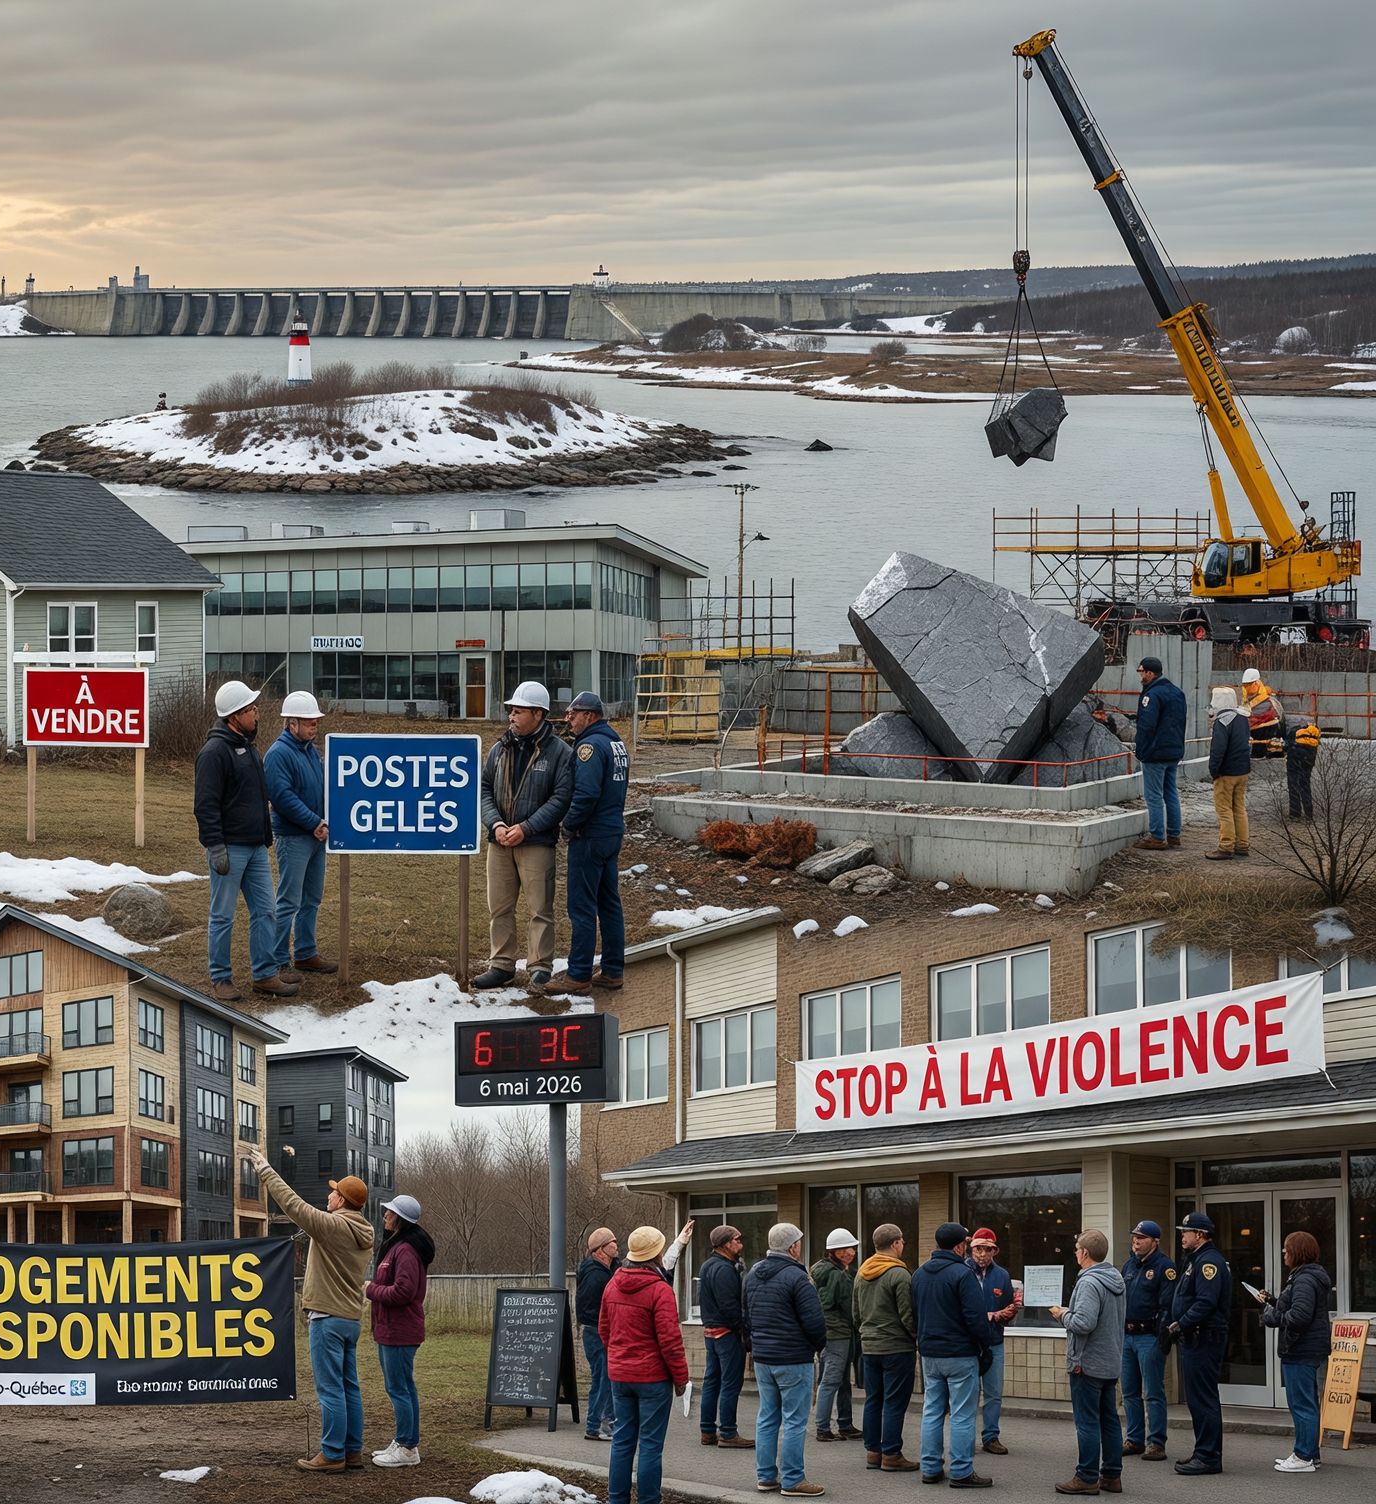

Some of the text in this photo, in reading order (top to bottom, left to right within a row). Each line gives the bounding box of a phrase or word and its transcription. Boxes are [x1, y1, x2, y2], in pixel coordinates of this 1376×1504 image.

[75, 675, 95, 705] À
[31, 708, 140, 735] VENDRE
[337, 755, 470, 788] POSTES
[350, 791, 459, 833] GELÉS
[474, 1031, 492, 1066] 6
[814, 995, 1289, 1120] STOP À LA VIOLENCE
[480, 1075, 582, 1096] 6 mai 2026
